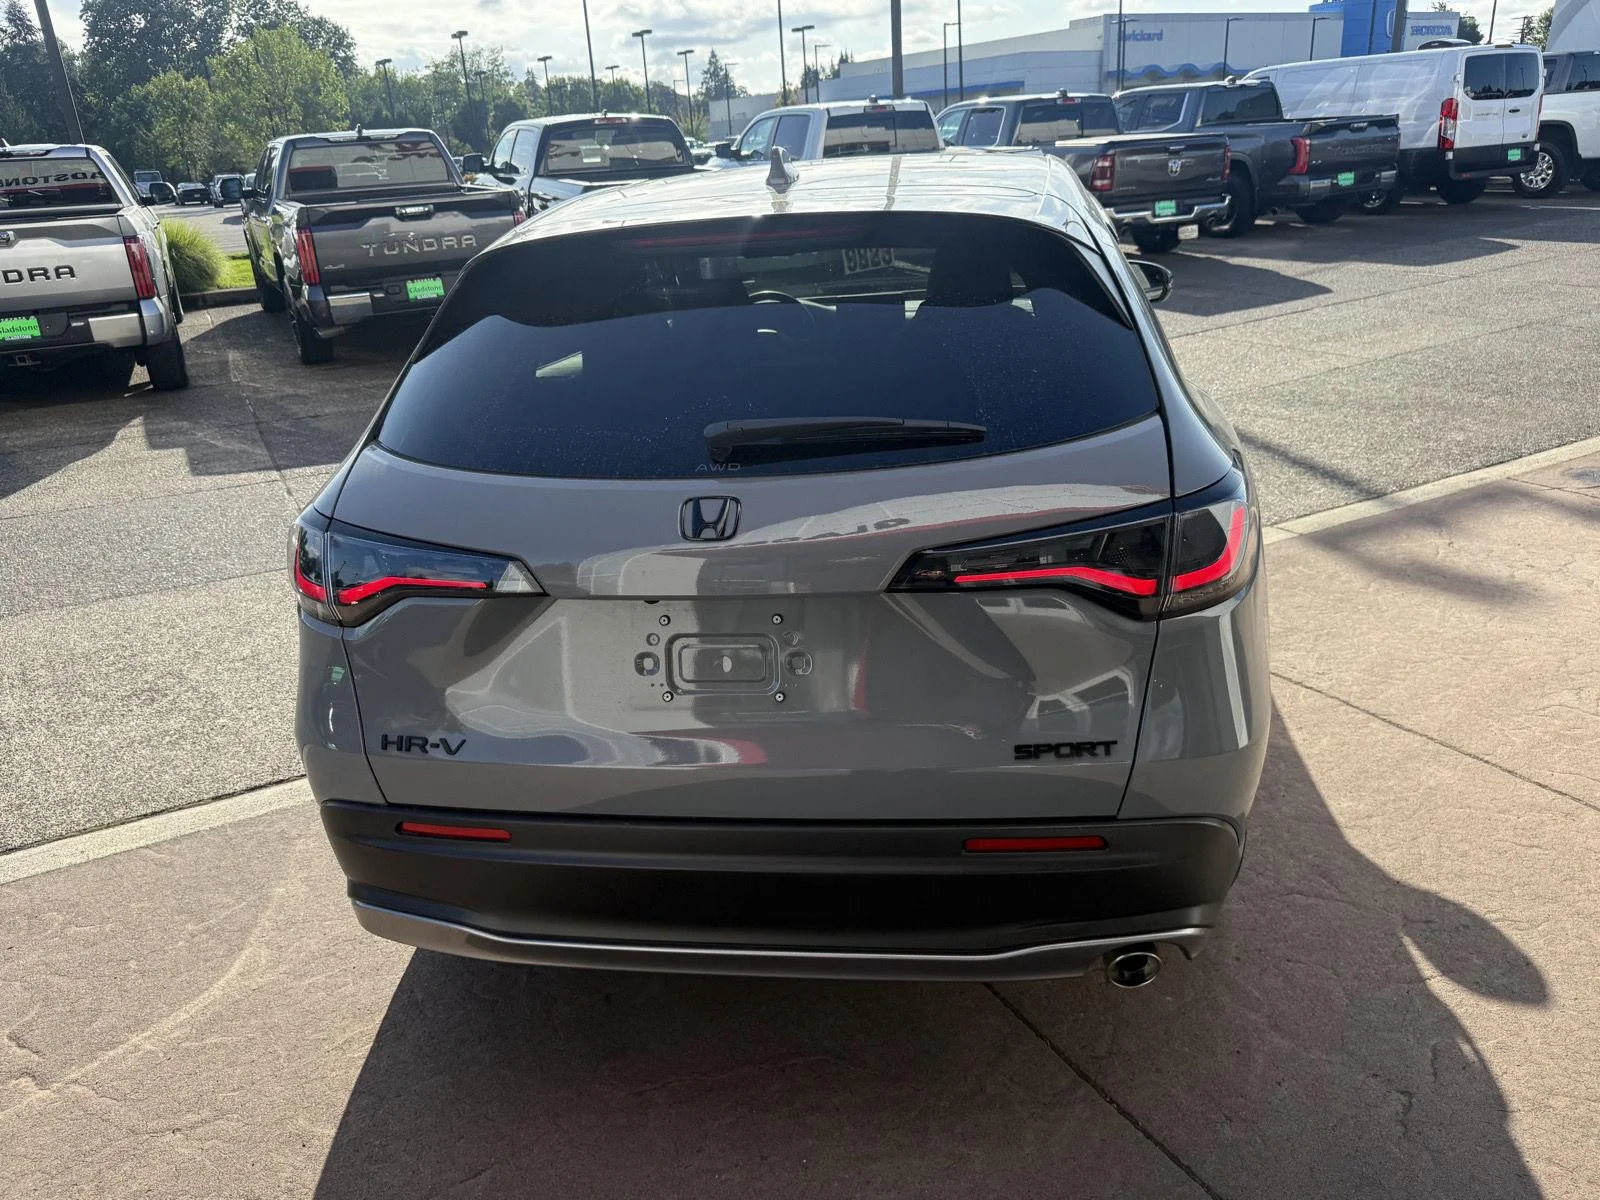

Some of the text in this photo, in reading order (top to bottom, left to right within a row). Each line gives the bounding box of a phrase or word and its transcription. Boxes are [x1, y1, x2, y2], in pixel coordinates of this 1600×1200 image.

[360, 234, 477, 257] TUNDRA
[2, 264, 76, 285] DRA
[0, 325, 38, 334] ladstone
[695, 463, 741, 472] AWD
[381, 734, 467, 756] HR-V
[1014, 740, 1118, 760] SPORT
